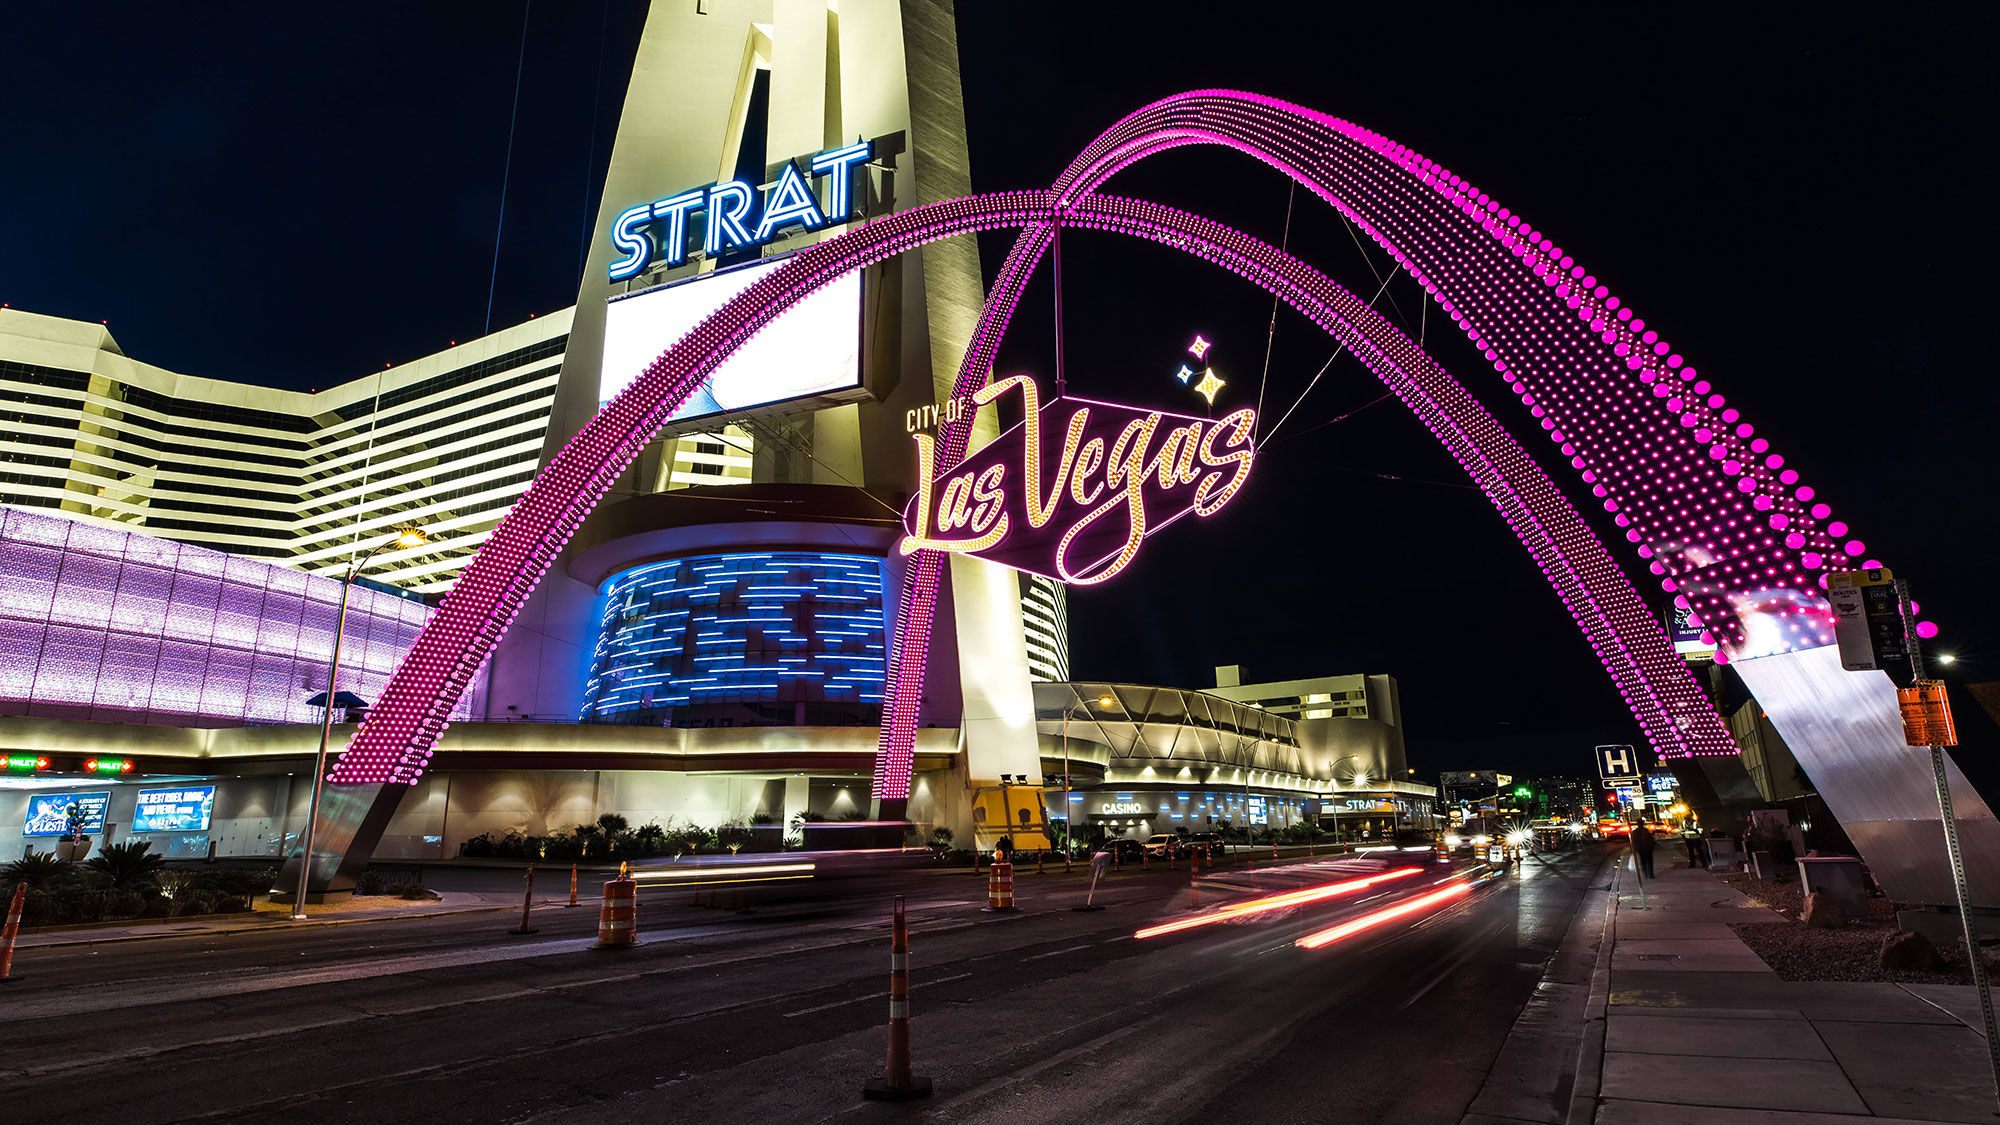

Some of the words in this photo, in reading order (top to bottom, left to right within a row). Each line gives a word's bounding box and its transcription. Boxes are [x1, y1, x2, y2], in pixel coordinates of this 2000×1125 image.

[608, 141, 872, 283] STRAT
[906, 403, 940, 432] CITY
[946, 396, 966, 422] OF
[900, 433, 1010, 555] Las
[972, 375, 1256, 585] Vegas
[9, 759, 38, 768] VALET
[97, 761, 123, 770] VALET
[1604, 749, 1630, 774] H
[1102, 802, 1142, 815] CASINO
[1346, 799, 1376, 810] STRAT
